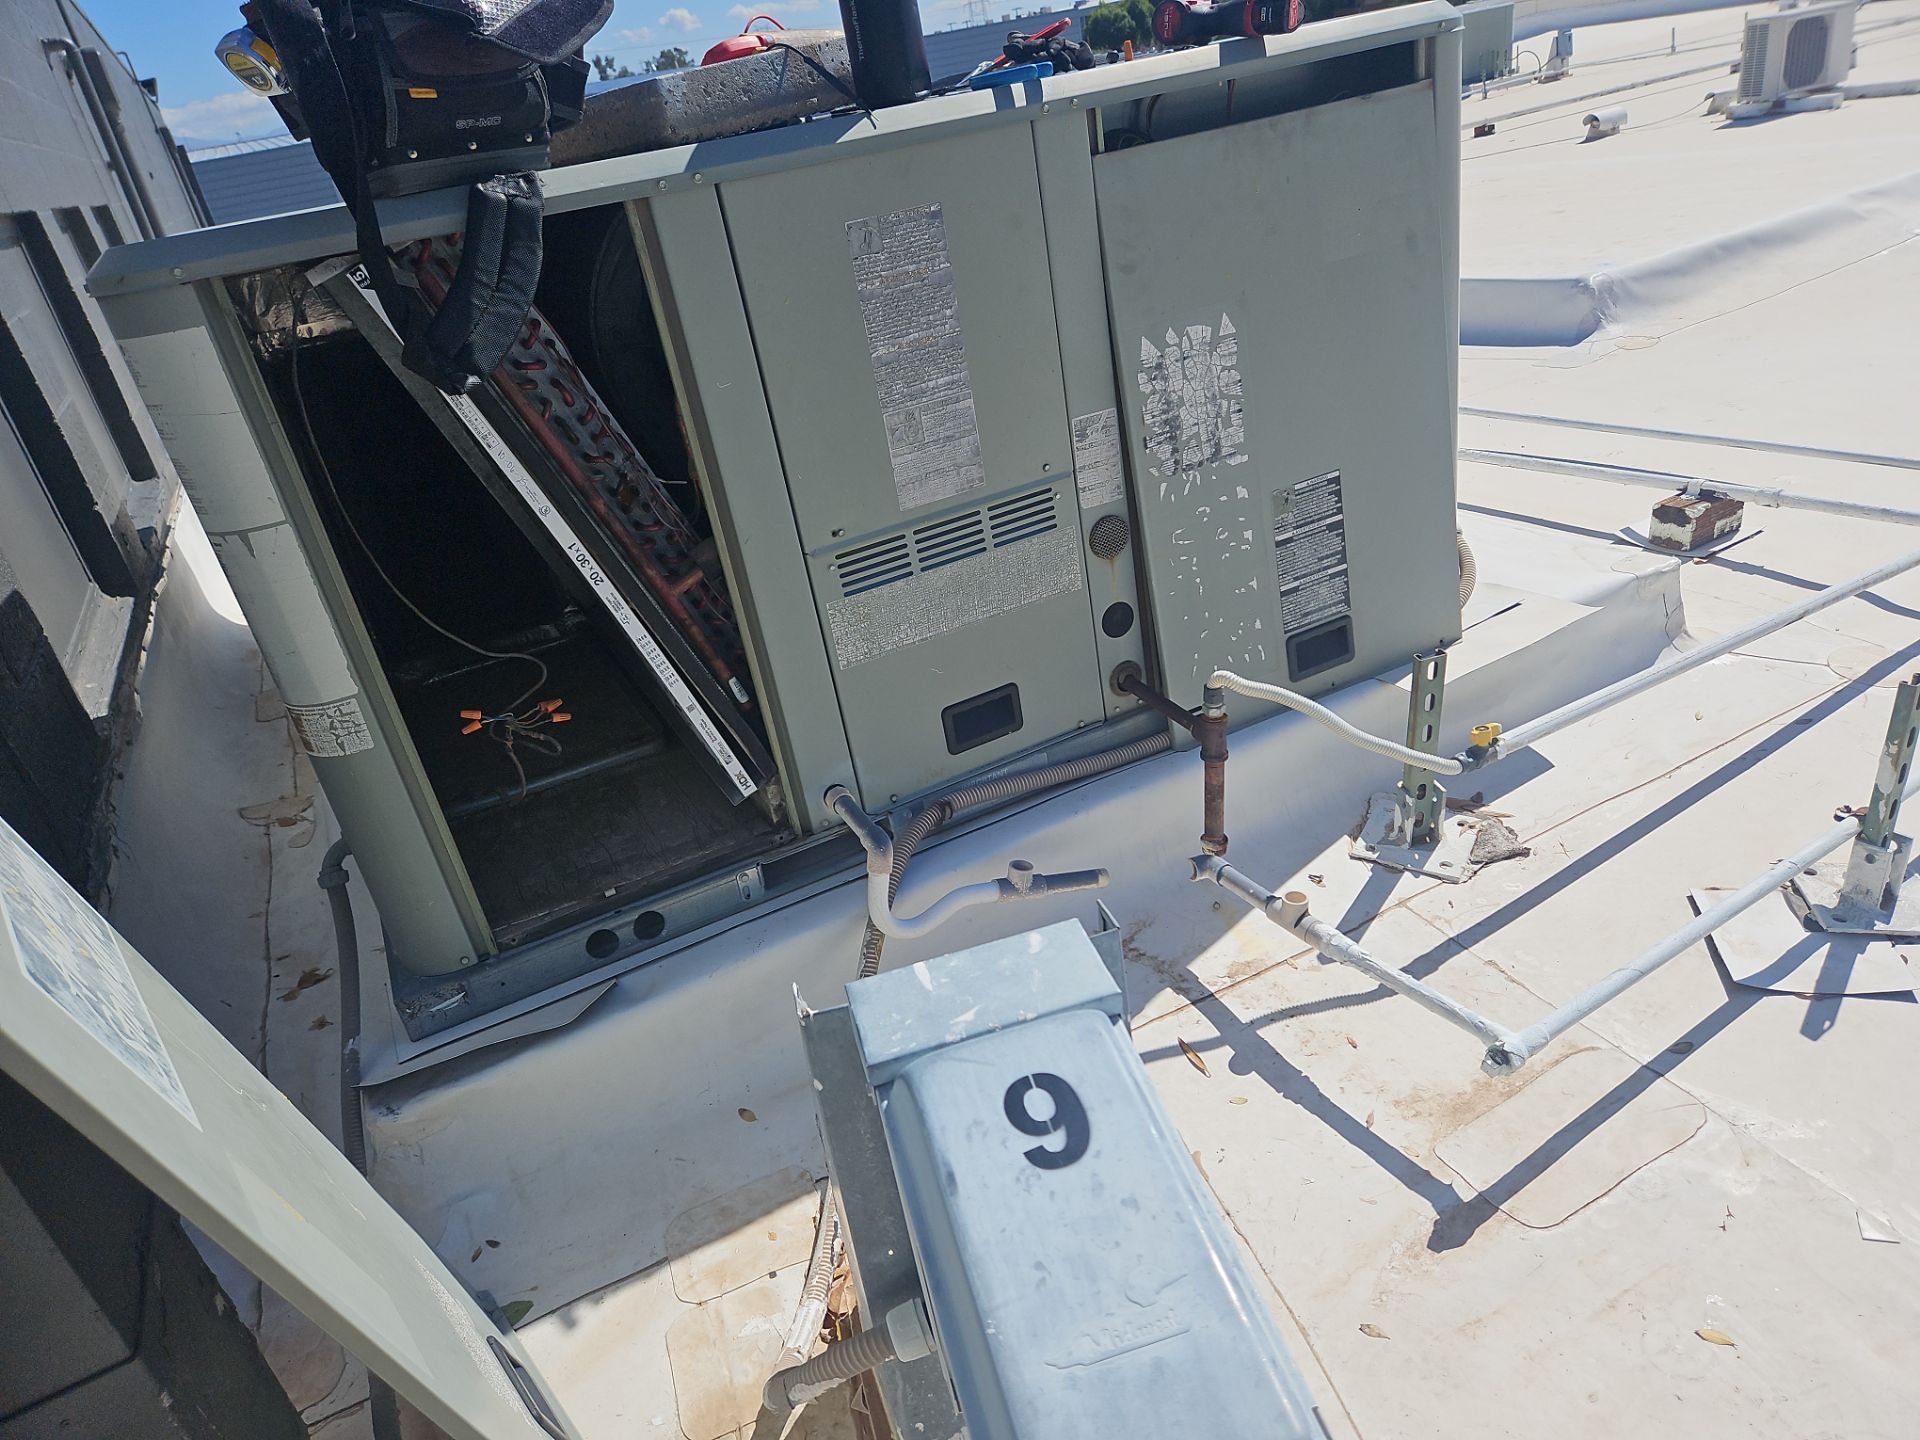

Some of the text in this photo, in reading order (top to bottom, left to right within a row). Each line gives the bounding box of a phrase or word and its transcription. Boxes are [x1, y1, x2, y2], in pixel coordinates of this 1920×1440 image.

[849, 0, 865, 62] ThermoFlask
[353, 271, 365, 281] 5
[734, 769, 752, 790] HDX
[1003, 1072, 1090, 1170] 9
